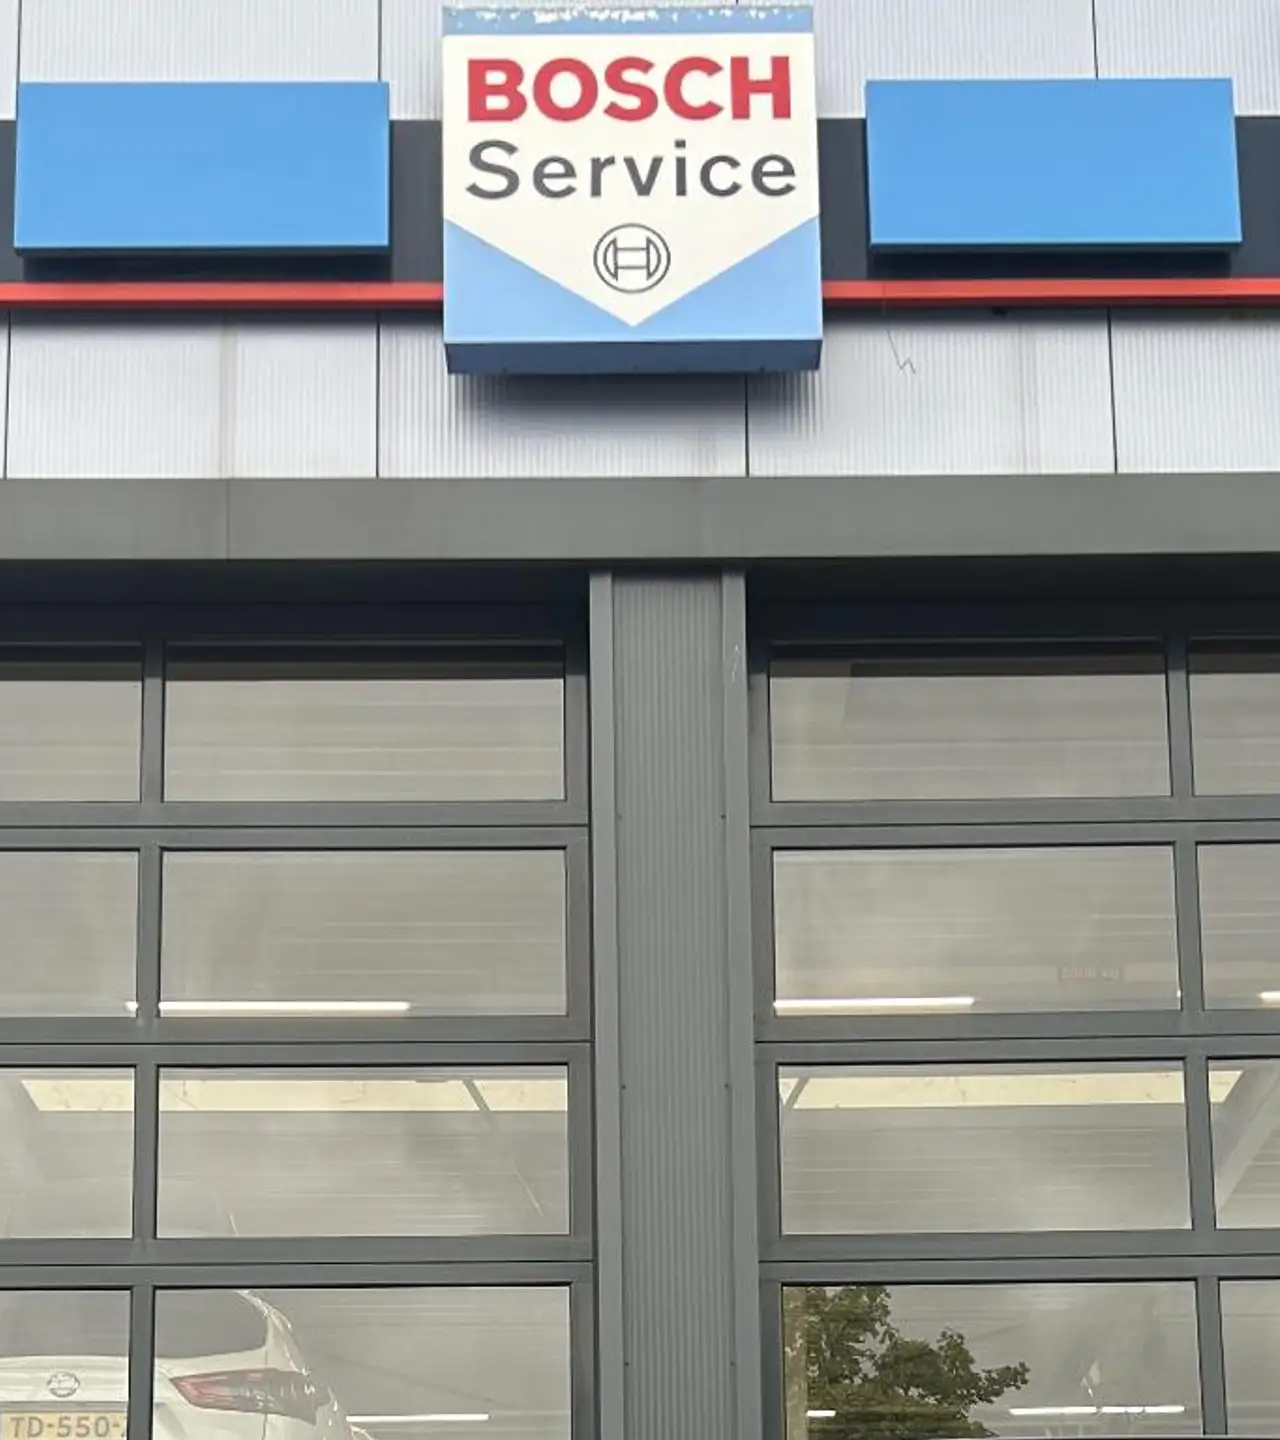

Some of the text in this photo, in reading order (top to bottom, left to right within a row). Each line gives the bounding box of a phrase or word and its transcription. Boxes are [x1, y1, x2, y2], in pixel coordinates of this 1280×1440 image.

[467, 56, 791, 121] BOSCH
[465, 139, 796, 199] Service
[9, 1416, 126, 1438] TD-550-
